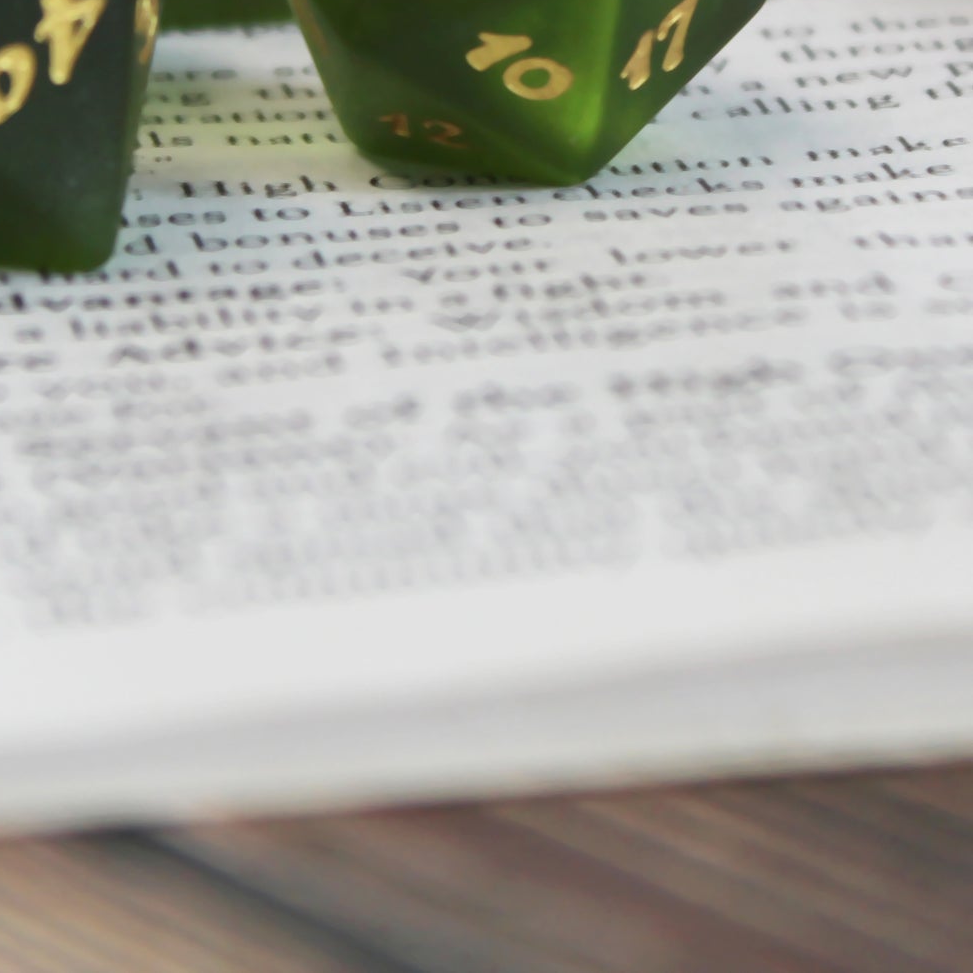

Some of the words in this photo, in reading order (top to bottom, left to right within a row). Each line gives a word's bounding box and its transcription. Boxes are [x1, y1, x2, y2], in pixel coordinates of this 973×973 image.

[464, 30, 575, 101] 10
[794, 65, 915, 90] new
[691, 94, 902, 121] calling
[178, 174, 337, 200] High
[805, 134, 971, 163] make
[251, 204, 312, 223] to
[337, 192, 528, 218] Listen
[551, 175, 766, 203] checks
[789, 161, 956, 189] make
[190, 220, 463, 254] bonuses
[491, 211, 553, 229] to
[582, 200, 750, 224] saves
[208, 257, 270, 276] to
[607, 238, 795, 266] lower
